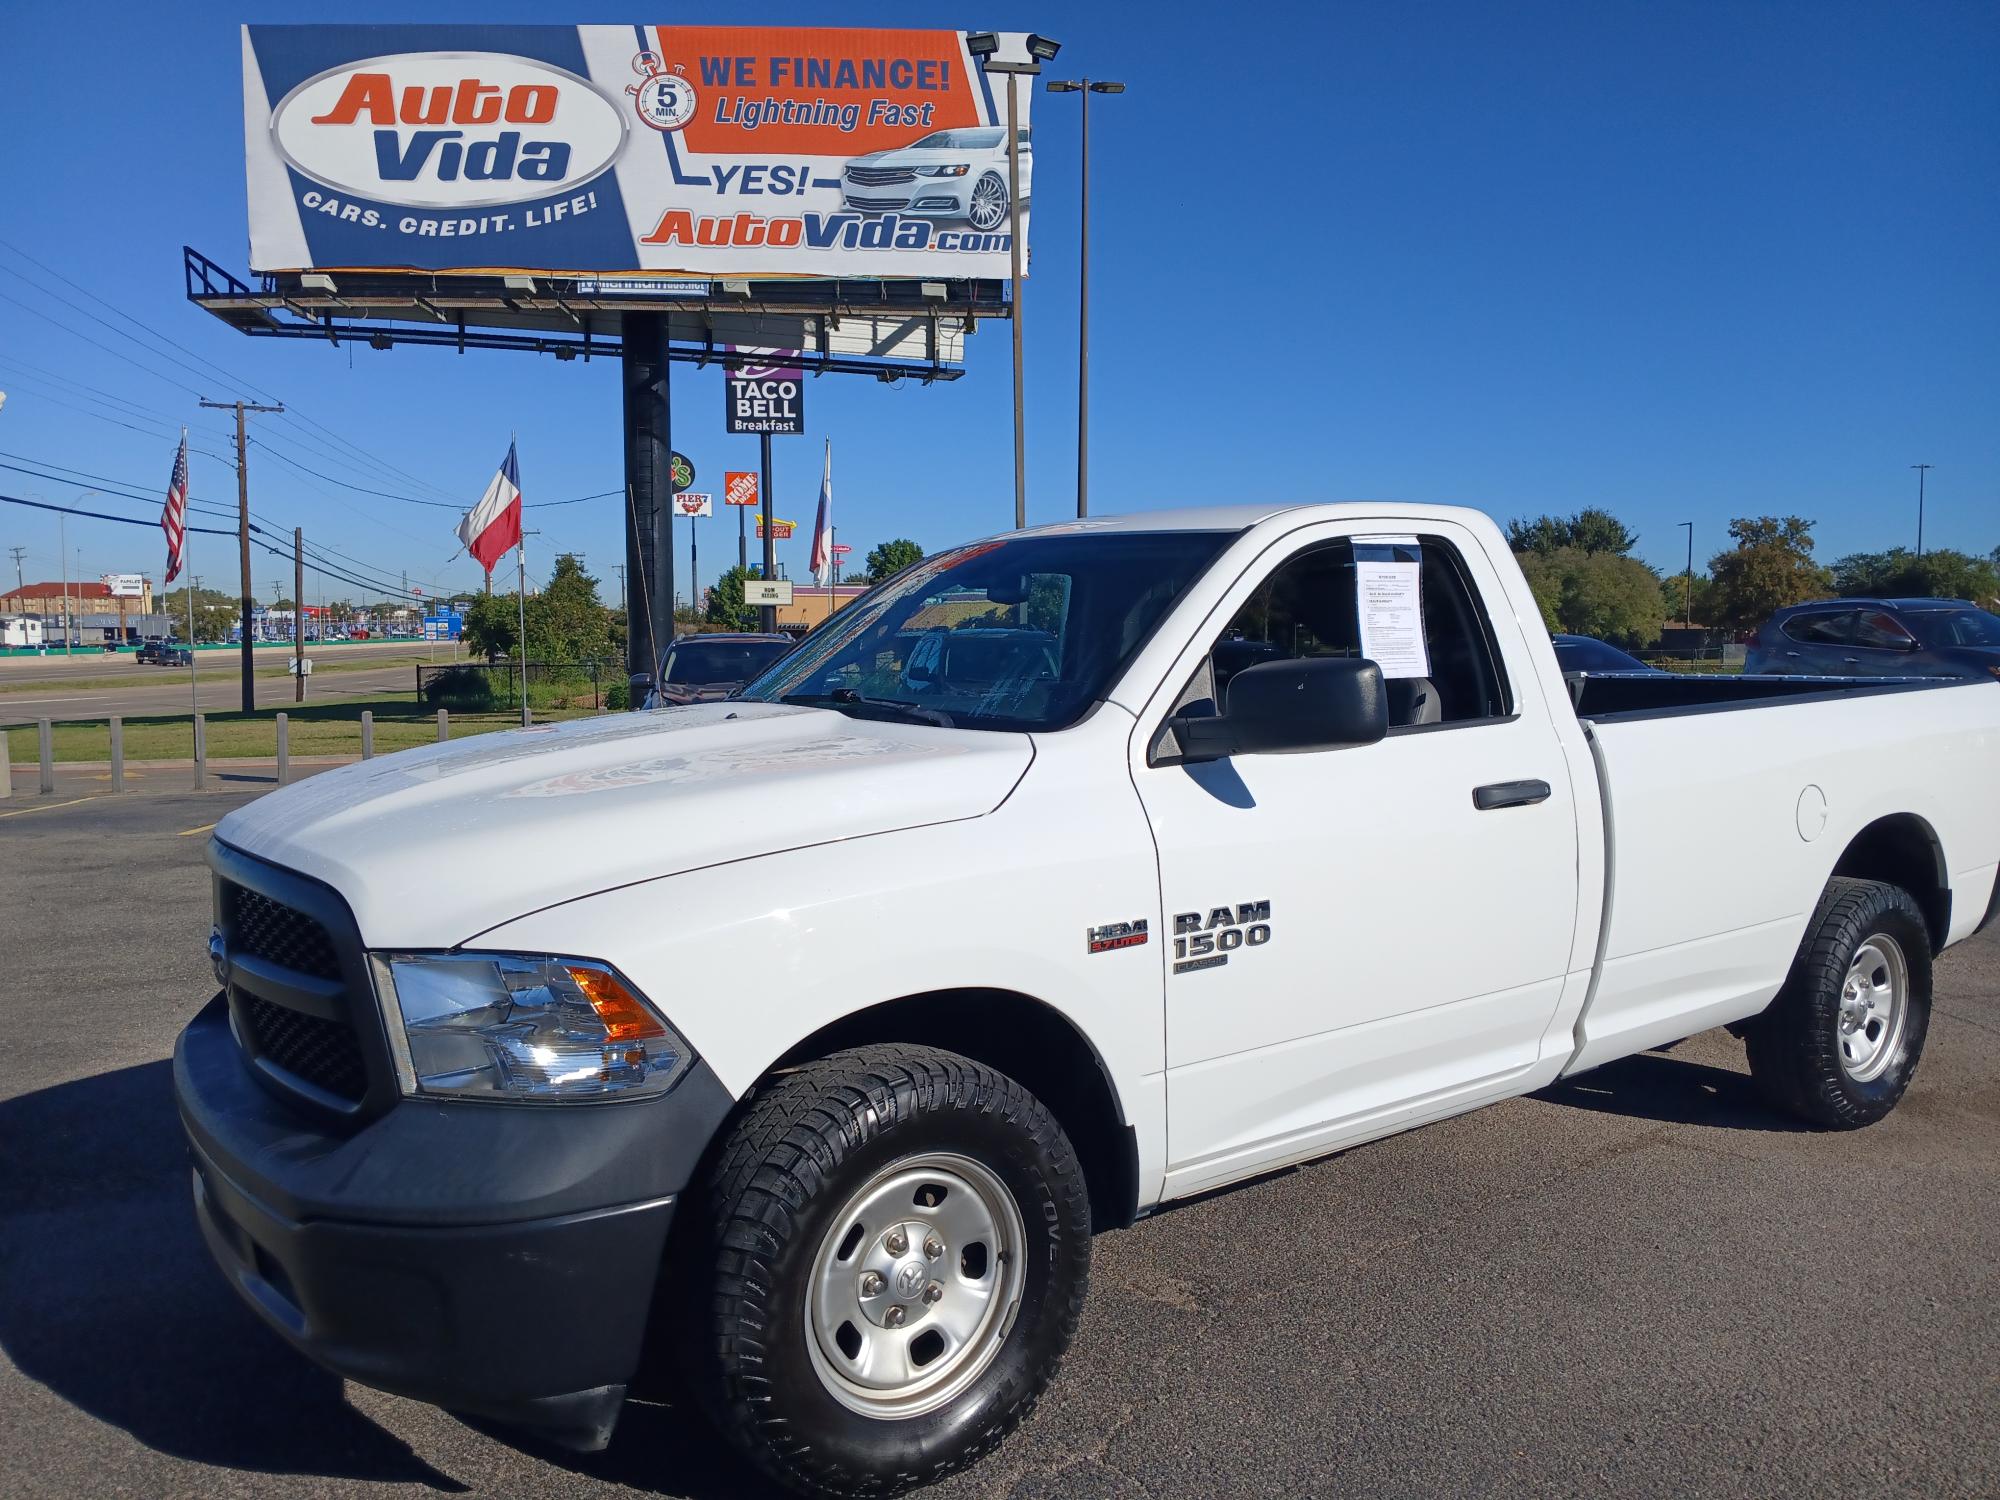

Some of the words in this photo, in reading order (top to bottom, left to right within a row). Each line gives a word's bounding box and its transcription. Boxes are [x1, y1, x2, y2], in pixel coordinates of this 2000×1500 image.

[699, 56, 756, 87] WE
[769, 57, 950, 91] FINANCE!
[310, 73, 559, 125] Auto
[657, 83, 677, 108] 5
[655, 107, 679, 117] MIN.
[714, 97, 861, 130] Lightning
[866, 99, 936, 127] Fast
[373, 130, 572, 181] Vida
[711, 165, 810, 195] YES!
[302, 191, 387, 230] CARS.
[399, 216, 515, 237] CREDIT.
[525, 192, 598, 228] LIFE!
[639, 209, 1012, 253] AutoVida.com
[731, 381, 797, 399] TACO
[737, 400, 796, 417] BELL
[735, 420, 794, 431] Breakfast
[726, 473, 757, 504] HOME
[1087, 919, 1148, 942] HEMI
[1173, 900, 1270, 935] RAM
[1174, 924, 1270, 959] 1500
